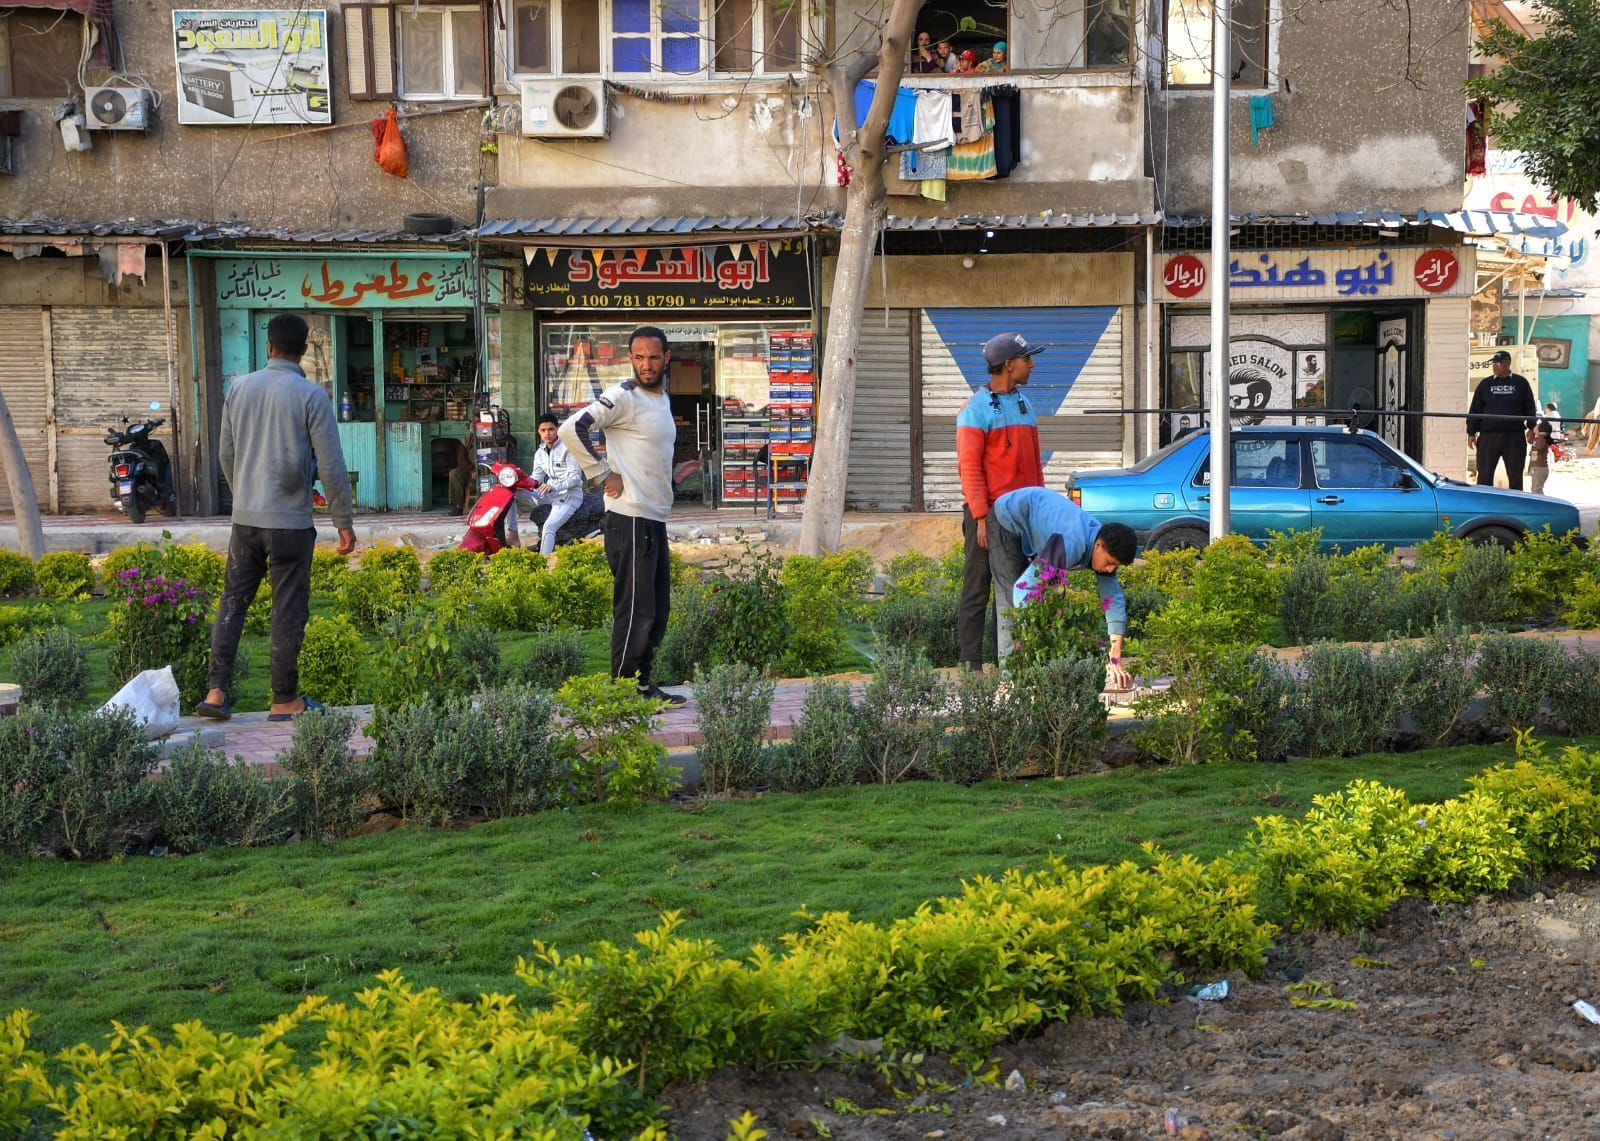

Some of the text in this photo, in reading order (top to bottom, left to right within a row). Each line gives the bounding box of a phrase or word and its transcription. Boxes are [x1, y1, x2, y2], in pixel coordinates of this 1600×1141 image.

[1163, 263, 1204, 289] للرجال
[1335, 251, 1393, 295] نيو
[1415, 258, 1455, 287] كوافير
[581, 295, 609, 307] 100
[613, 295, 641, 307] 781
[646, 295, 685, 307] 8790
[1250, 354, 1287, 379] SALON
